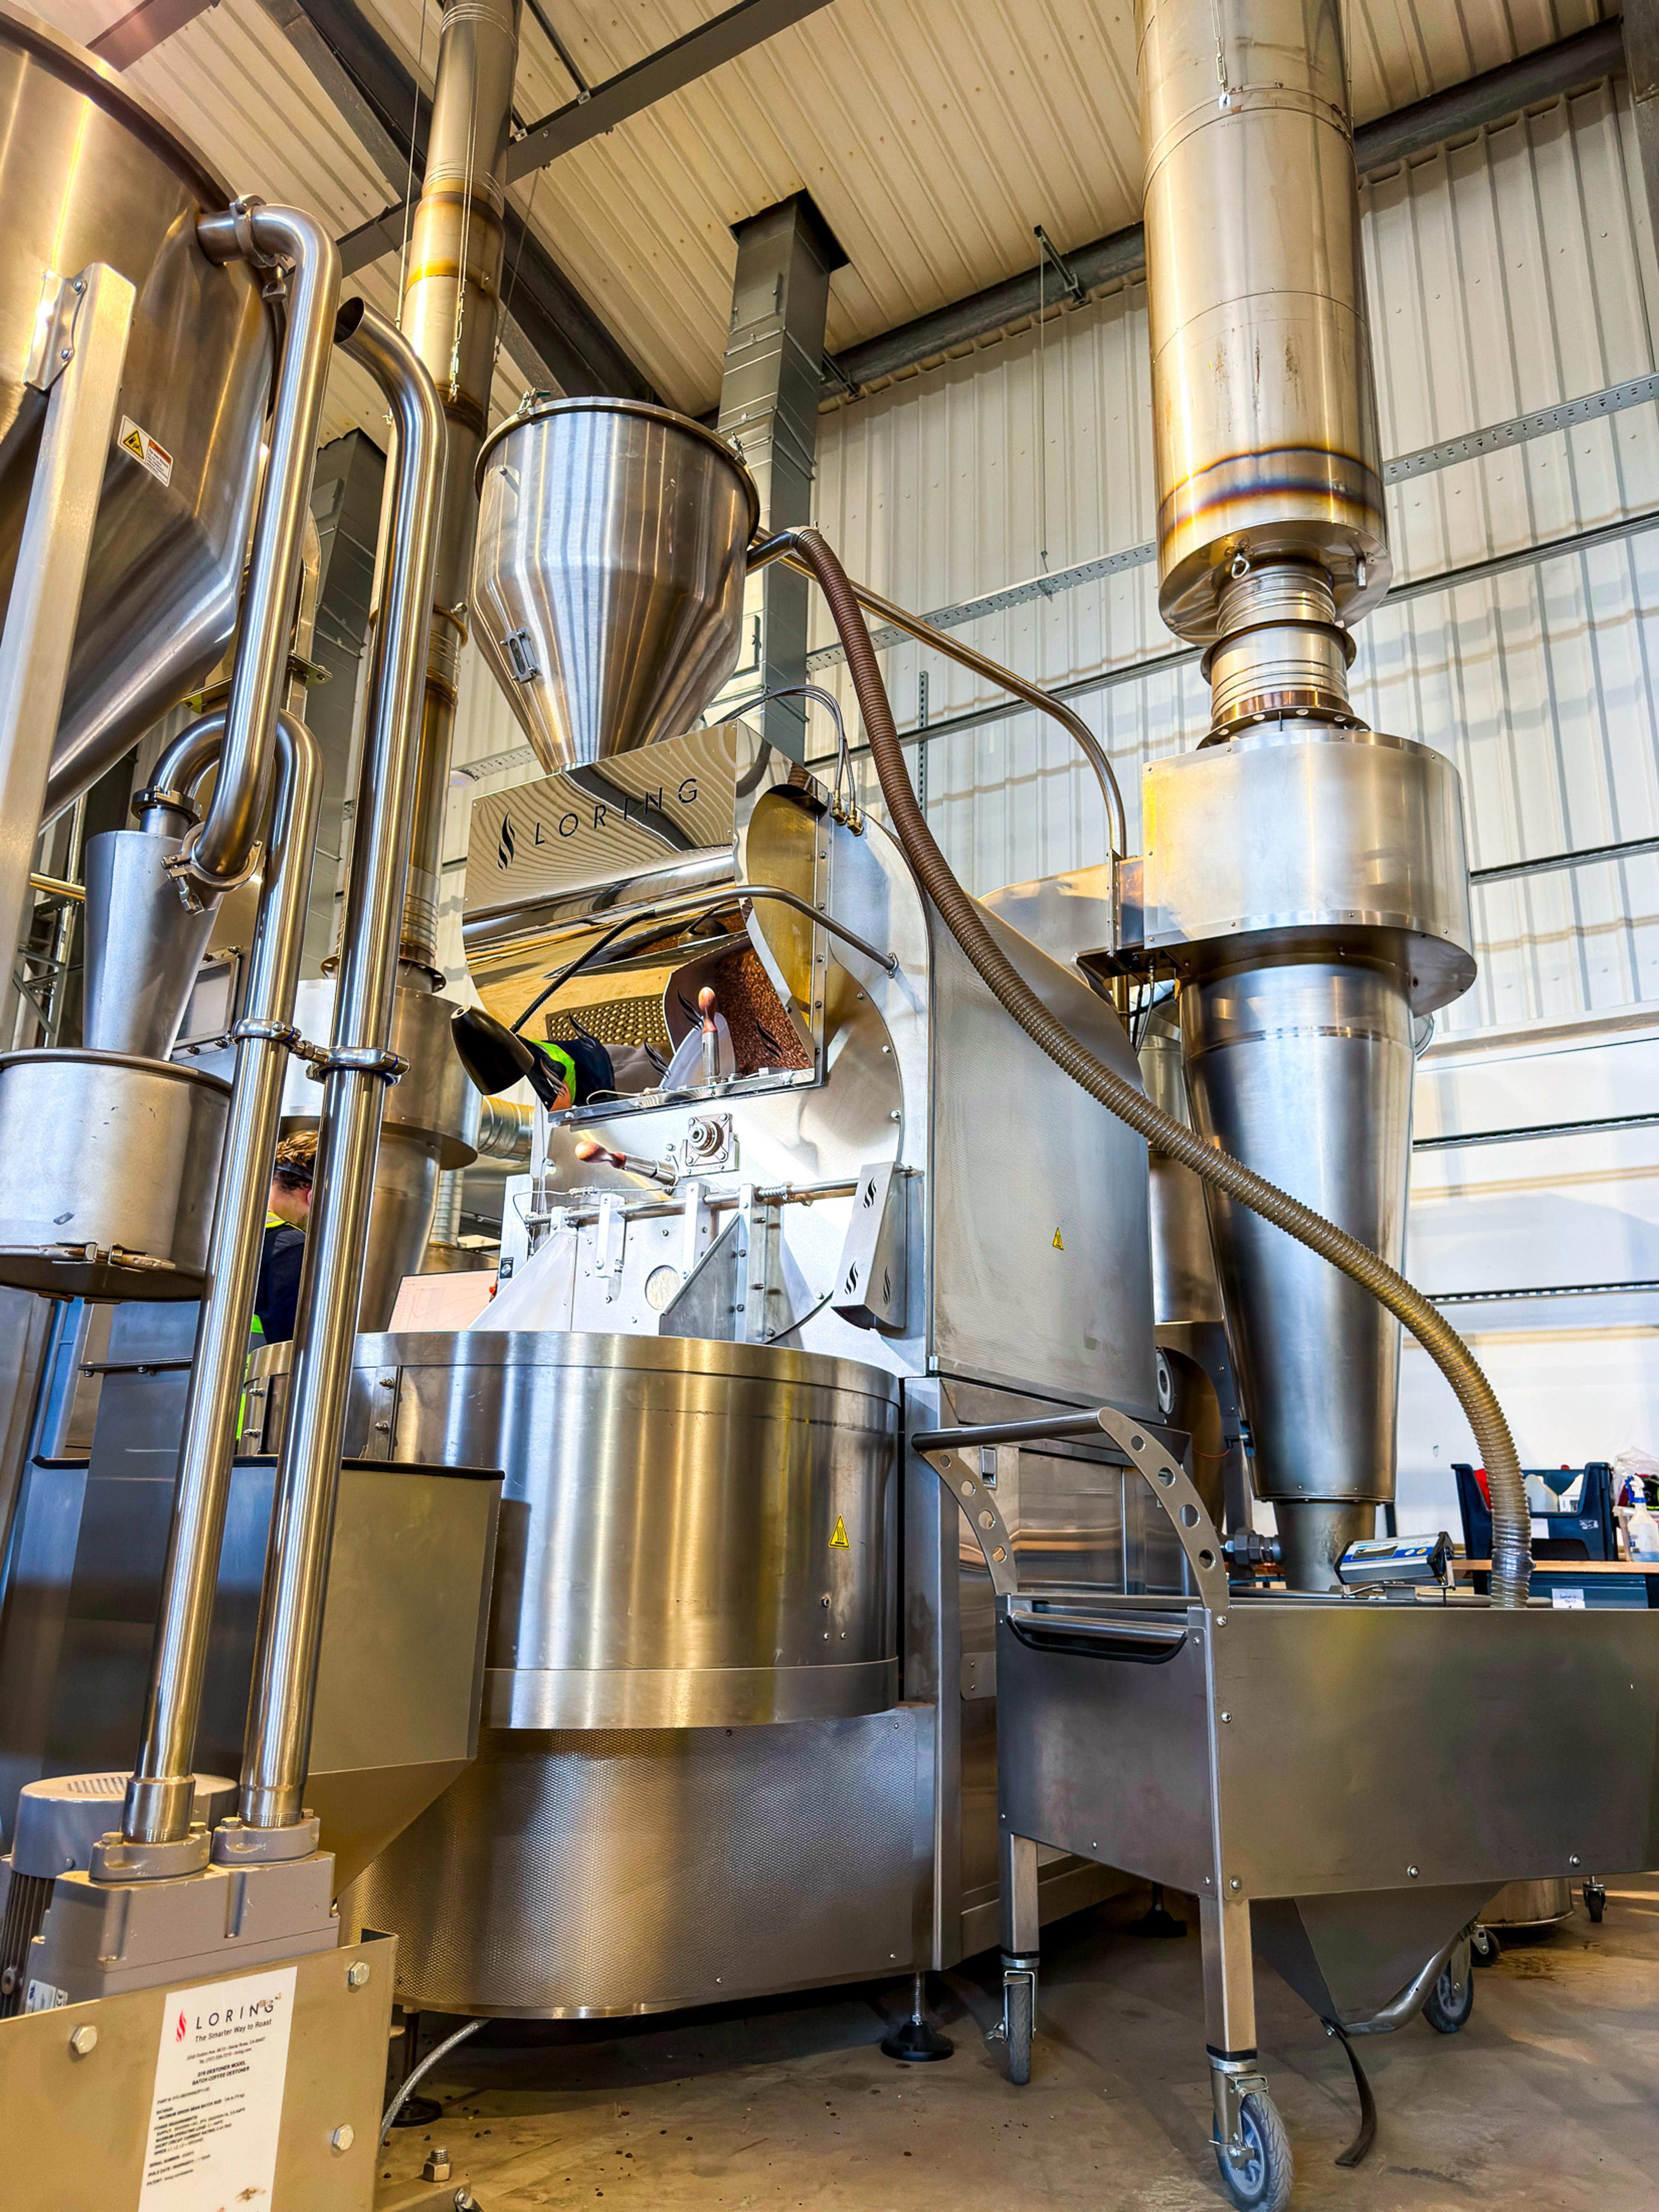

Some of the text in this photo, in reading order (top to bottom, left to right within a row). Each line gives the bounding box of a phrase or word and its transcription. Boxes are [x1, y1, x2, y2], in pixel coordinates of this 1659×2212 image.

[534, 778, 698, 845] LORING
[195, 2018, 272, 2043] The Smarter Way to Roast
[208, 2072, 226, 2081] COFFEE
